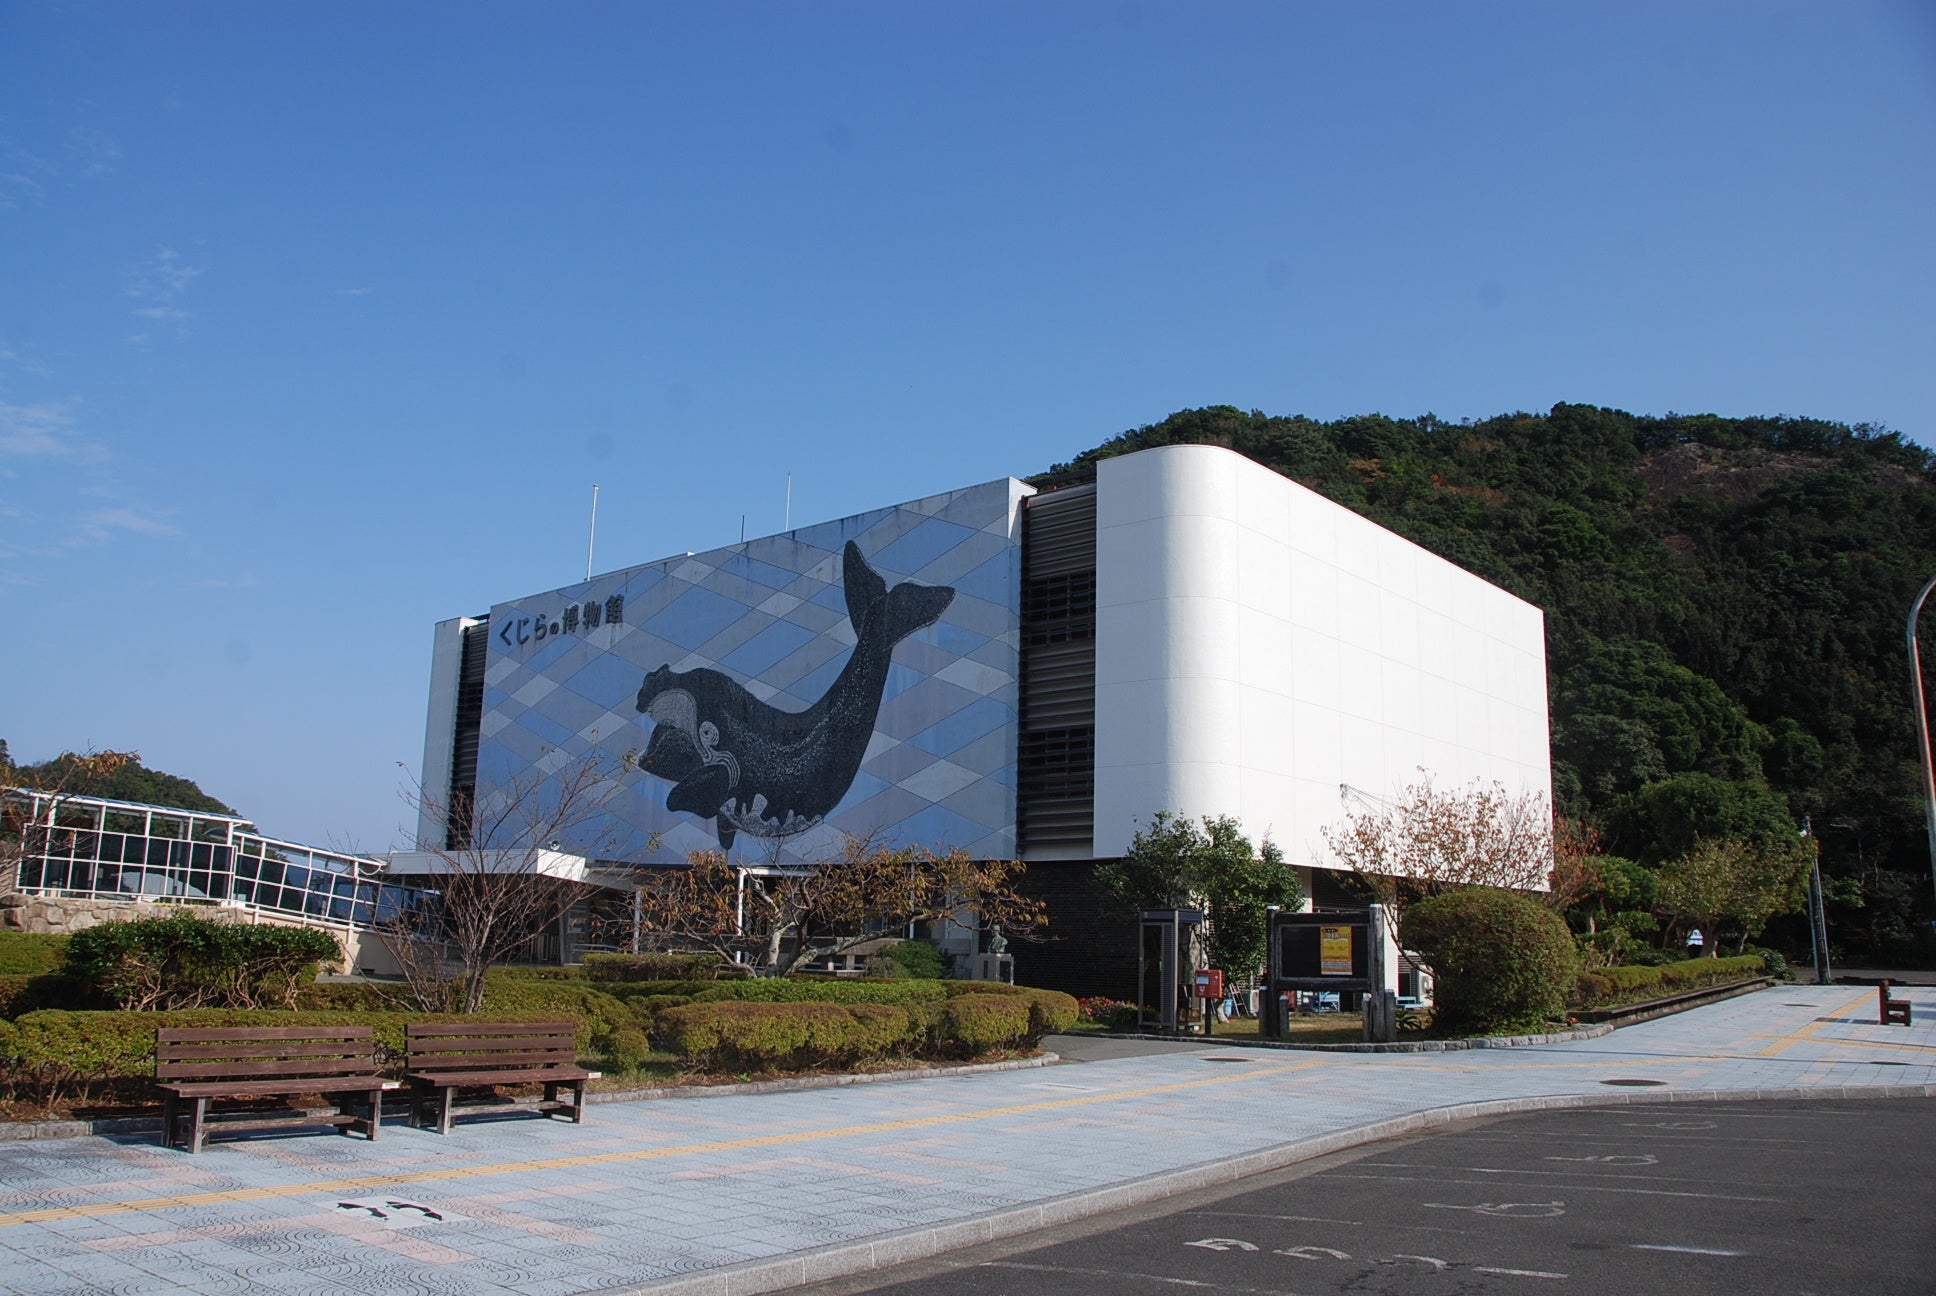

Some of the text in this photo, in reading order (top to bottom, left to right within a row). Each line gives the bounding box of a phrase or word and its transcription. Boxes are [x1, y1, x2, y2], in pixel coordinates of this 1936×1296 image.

[499, 594, 624, 647] くじらの博物館
